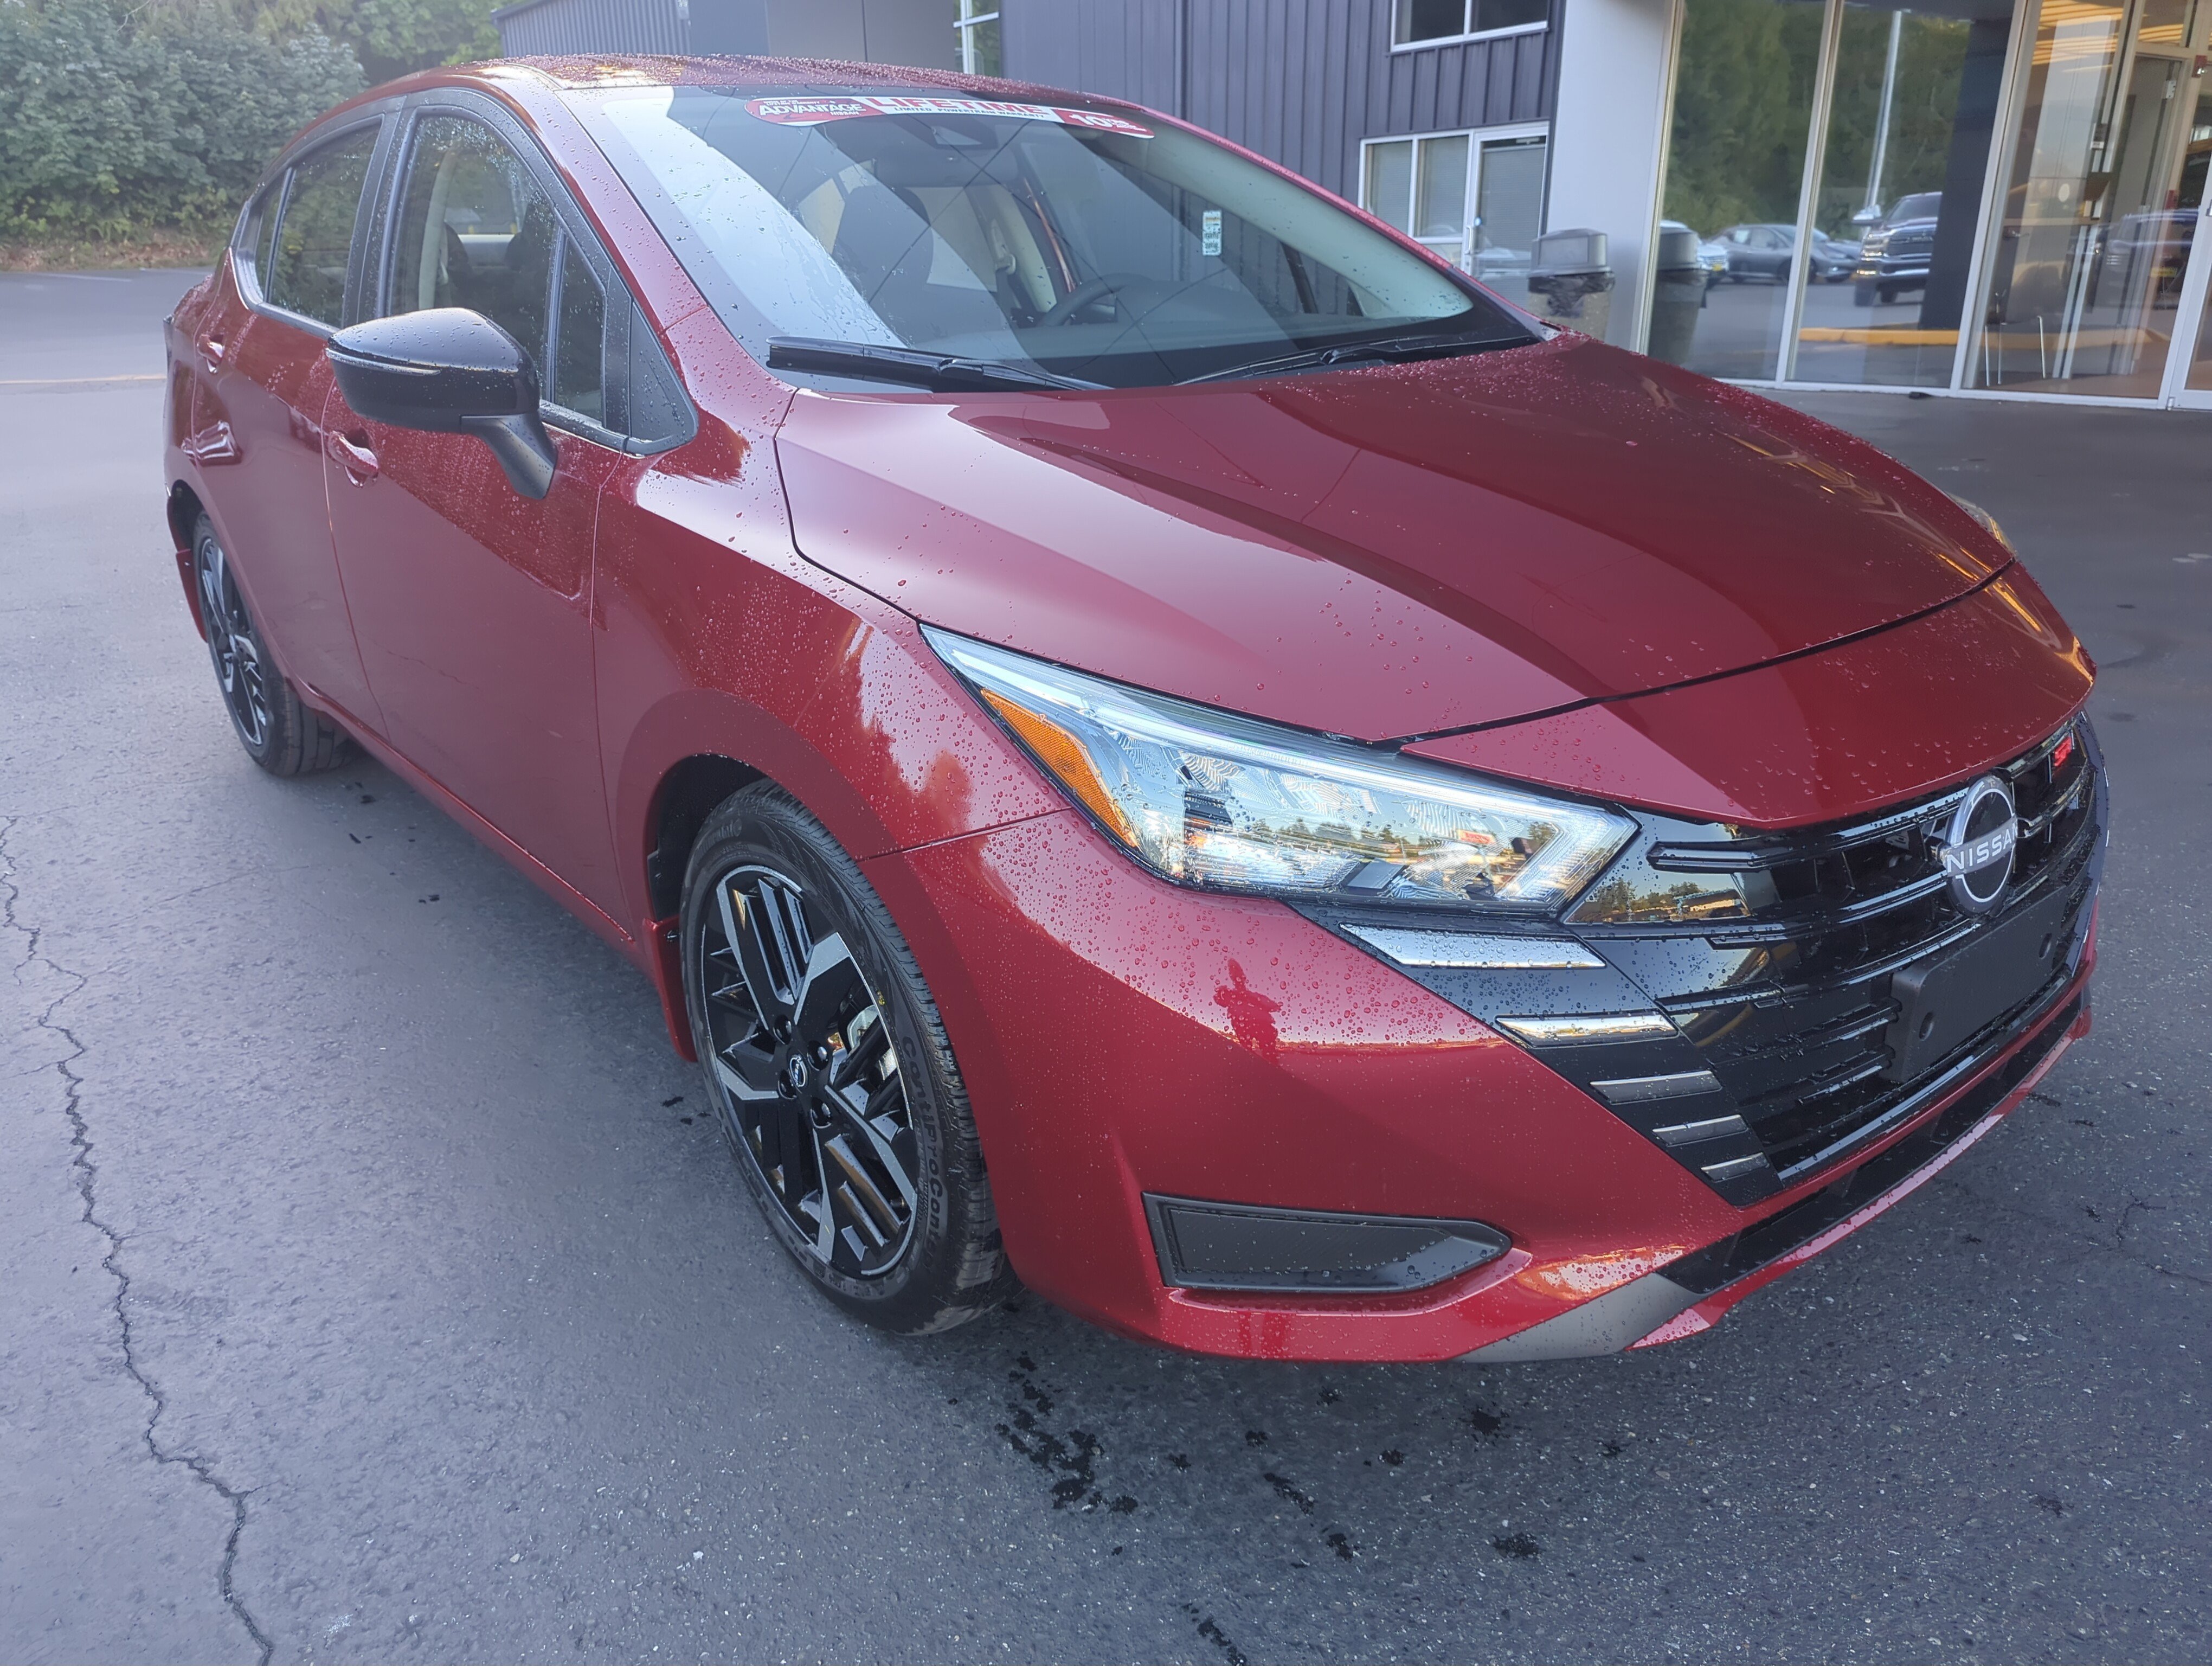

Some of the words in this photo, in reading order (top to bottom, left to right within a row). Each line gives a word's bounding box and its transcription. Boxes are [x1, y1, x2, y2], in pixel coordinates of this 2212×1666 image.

[759, 103, 867, 116] ADVANTAGE
[865, 98, 1050, 115] LIFETIME
[1069, 113, 1113, 127] 10
[1946, 821, 2018, 873] NISSAN
[902, 1036, 943, 1272] ContiProCont
